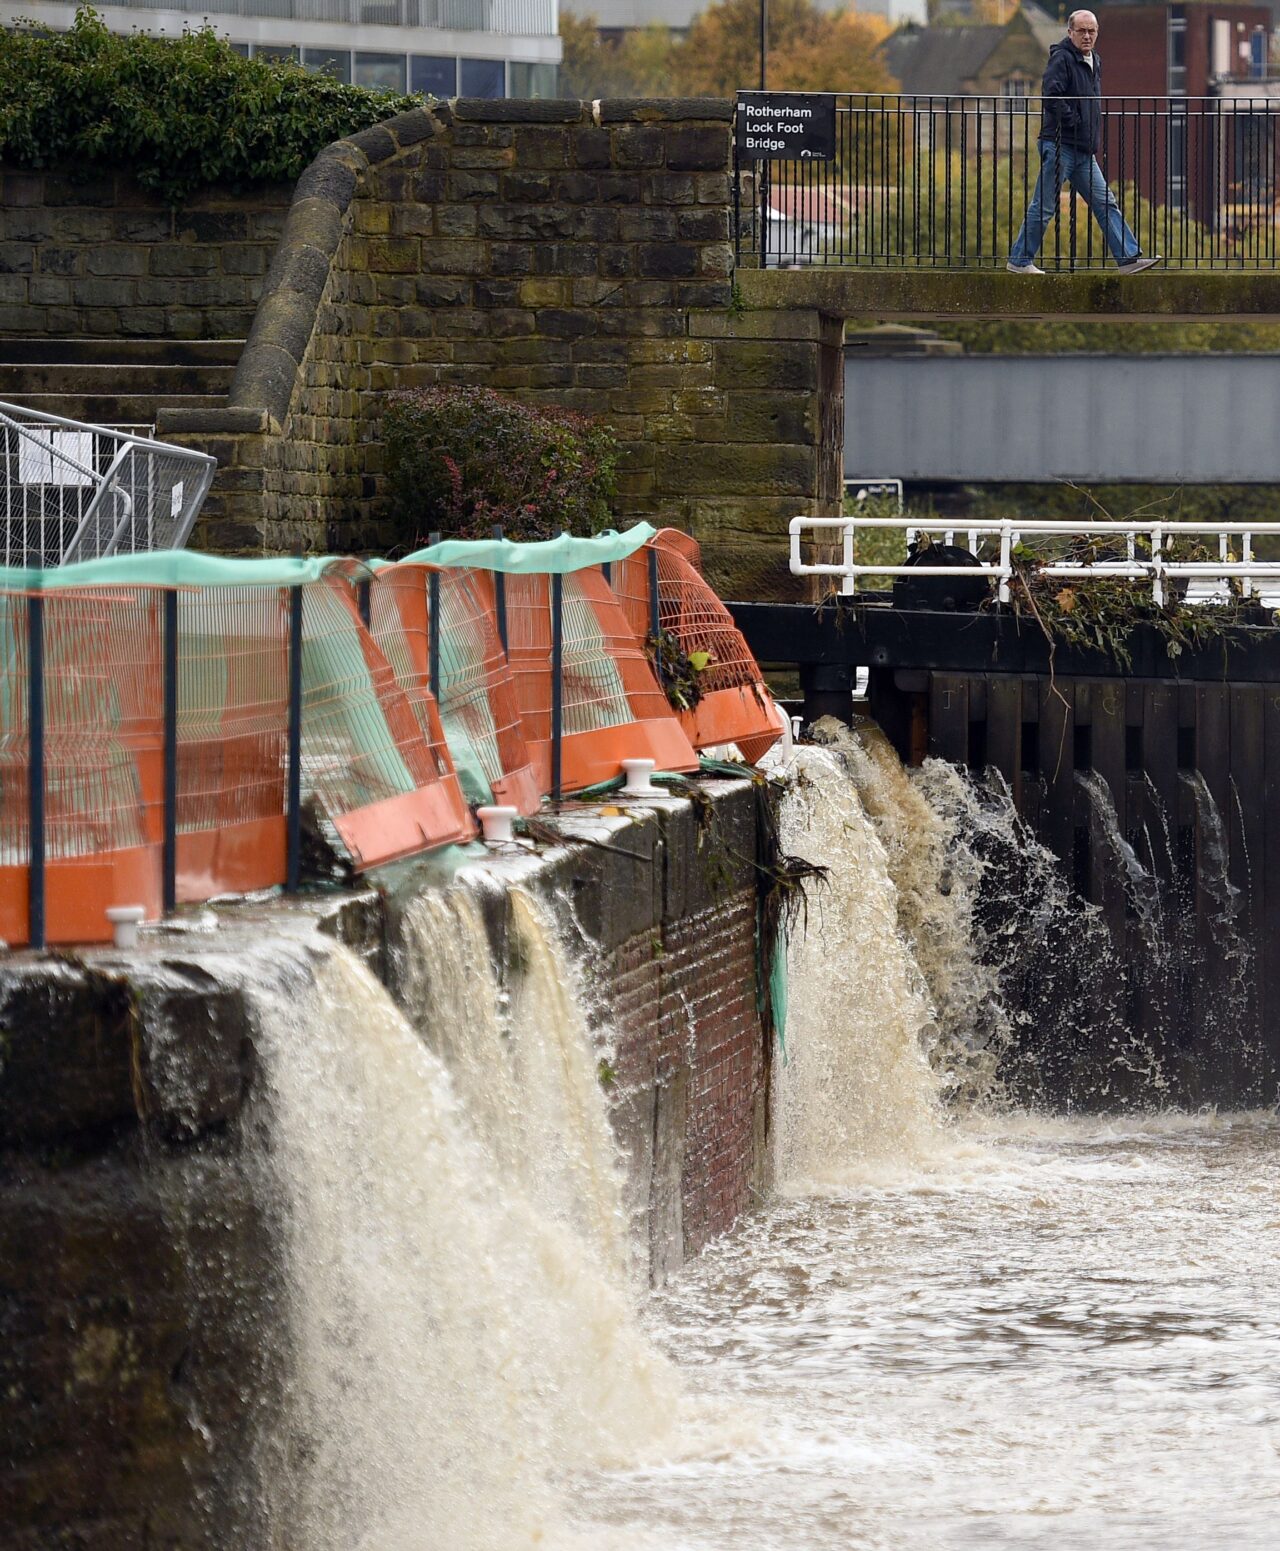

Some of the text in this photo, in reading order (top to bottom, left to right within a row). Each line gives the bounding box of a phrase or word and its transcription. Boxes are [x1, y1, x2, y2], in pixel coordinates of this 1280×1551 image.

[746, 106, 812, 117] Rotherham
[746, 122, 804, 133] Lock Foot
[746, 137, 785, 150] Bridge
